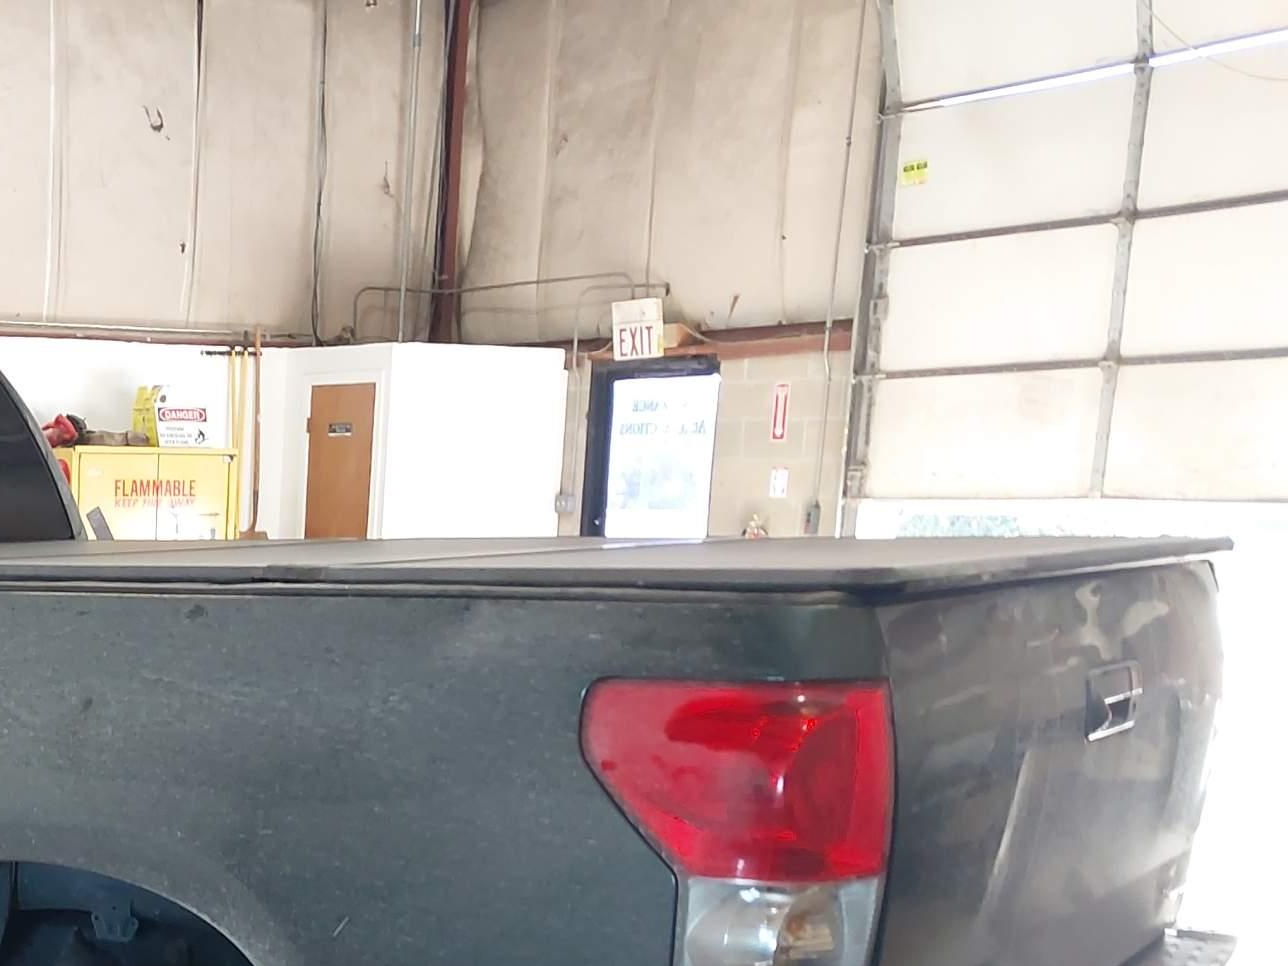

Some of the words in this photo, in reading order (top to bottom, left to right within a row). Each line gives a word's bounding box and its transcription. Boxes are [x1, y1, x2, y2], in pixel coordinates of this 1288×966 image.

[619, 326, 654, 357] EXIT
[164, 410, 201, 420] DANGER
[114, 479, 196, 497] FLAMMABLE
